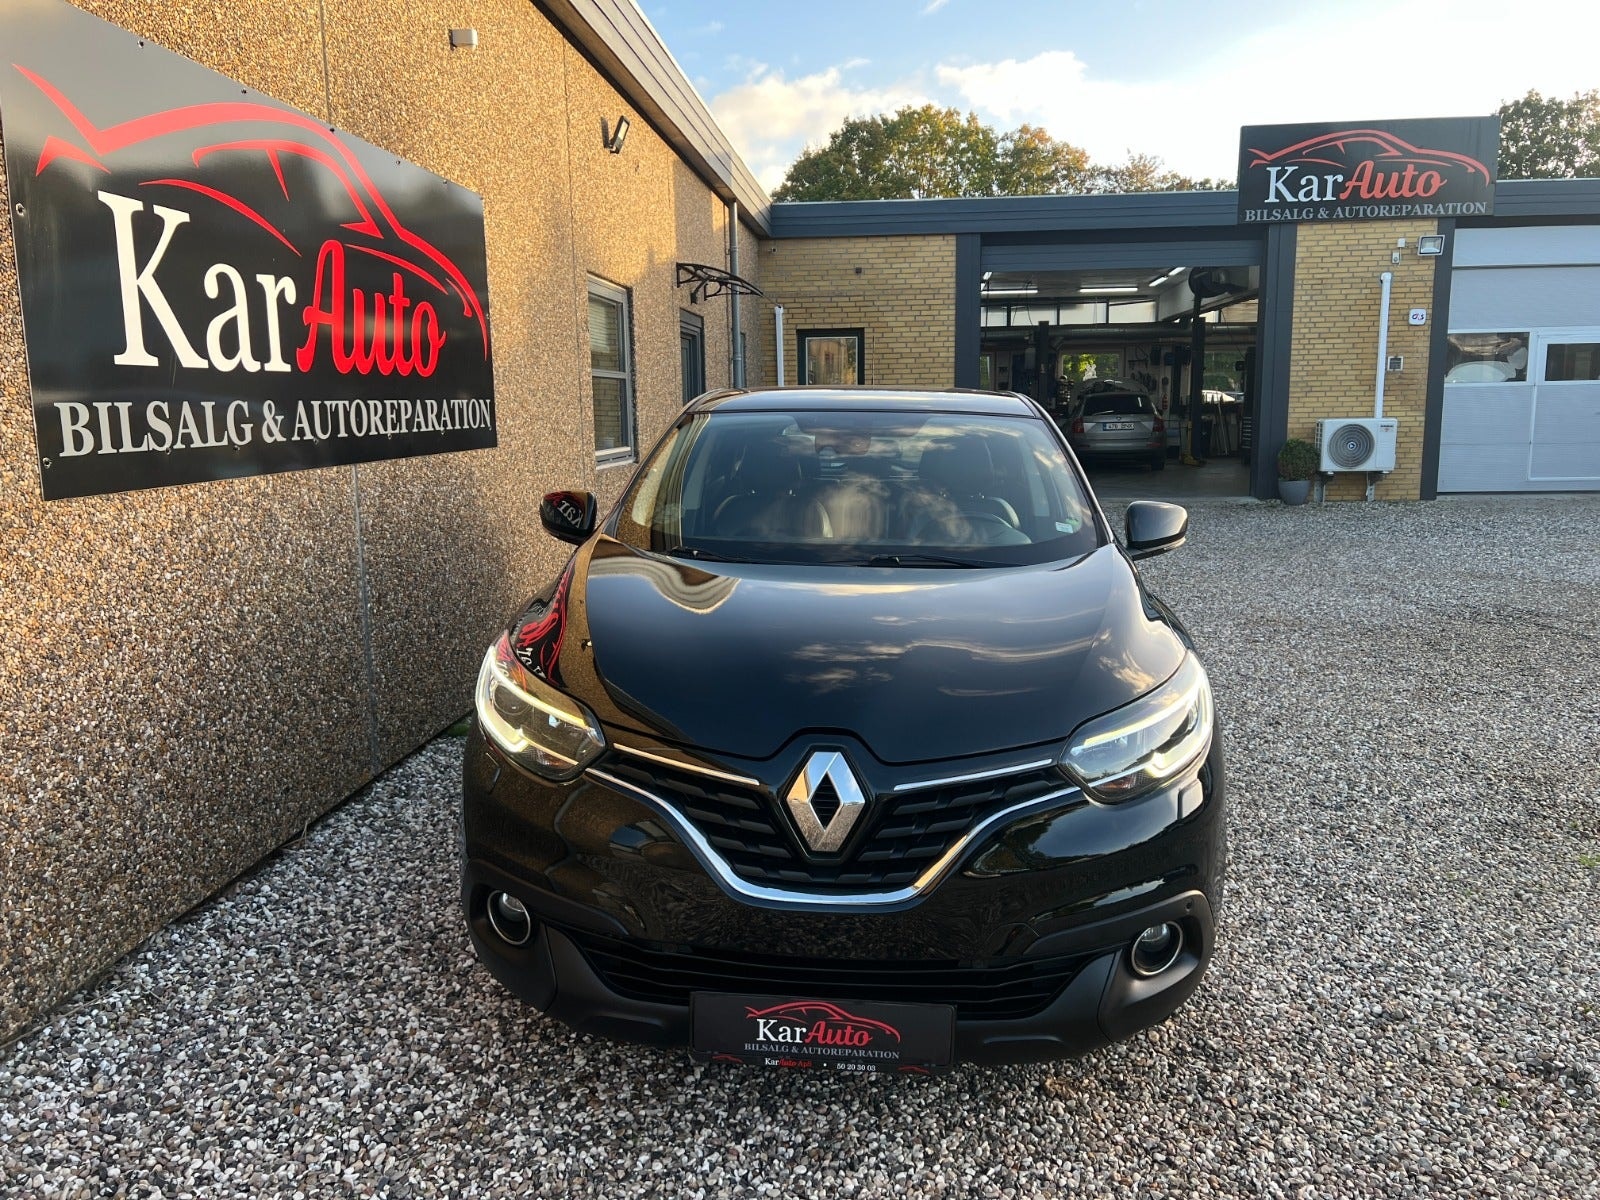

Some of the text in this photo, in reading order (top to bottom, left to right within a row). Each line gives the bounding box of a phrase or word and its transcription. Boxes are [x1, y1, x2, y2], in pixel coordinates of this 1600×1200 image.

[1264, 160, 1448, 204] KarAuto
[1245, 201, 1487, 221] BILSALG & AUTOREPARATION
[98, 190, 447, 377] KarAuto
[54, 399, 492, 457] BILSALG & AUTOREPARATION
[756, 1018, 873, 1046] KarAuto
[744, 1043, 900, 1060] BILSALG & AUTOREPARATION
